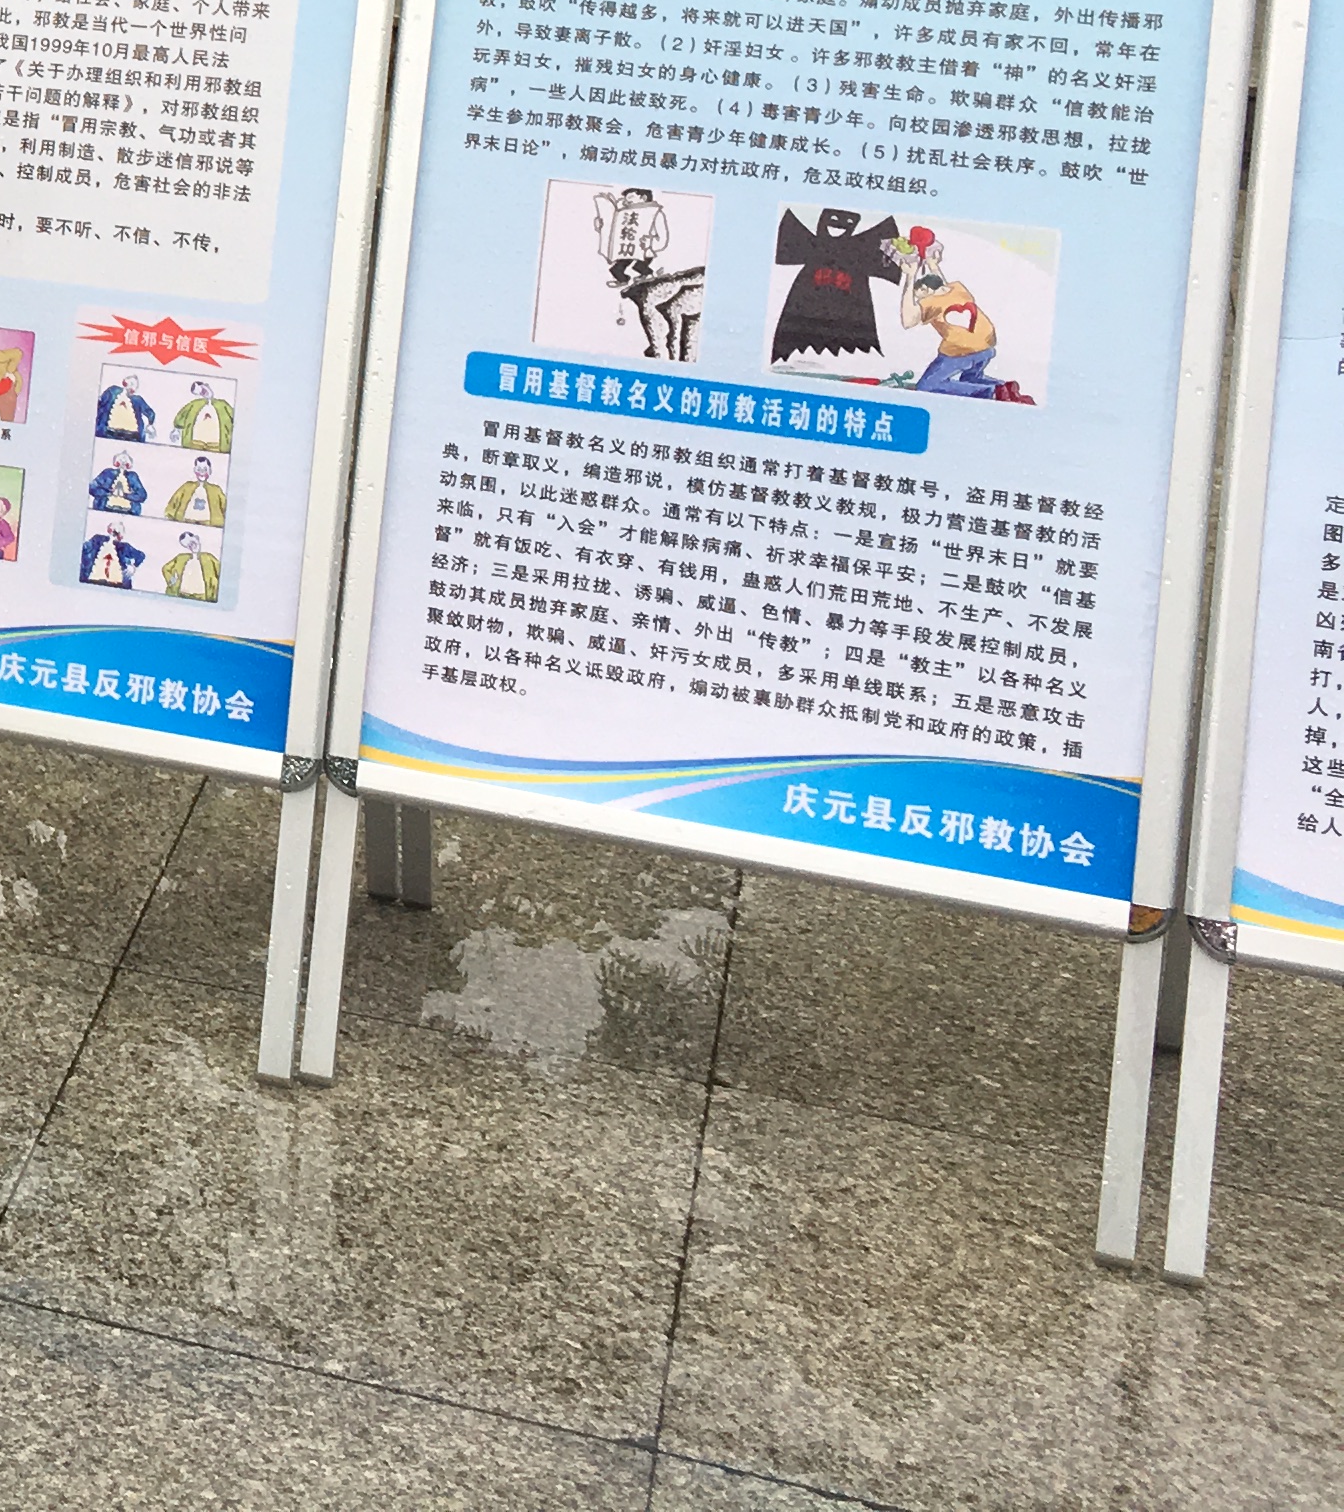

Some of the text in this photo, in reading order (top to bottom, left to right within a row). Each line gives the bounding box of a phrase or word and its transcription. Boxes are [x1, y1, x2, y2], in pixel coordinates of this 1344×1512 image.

[617, 210, 640, 258] 法轮功
[122, 327, 209, 356] 信邪与信医
[497, 360, 895, 444] 冒用基督教名义的邪教活动的特点
[1323, 524, 1344, 544] 图
[1321, 553, 1341, 572] 多
[1317, 580, 1344, 602] 是
[1316, 611, 1344, 631] 凶
[420, 661, 528, 697] 手基层政权。
[1302, 755, 1344, 779] 这些
[782, 777, 1099, 872] 庆元县反邪教协会
[1297, 812, 1343, 838] 给人
